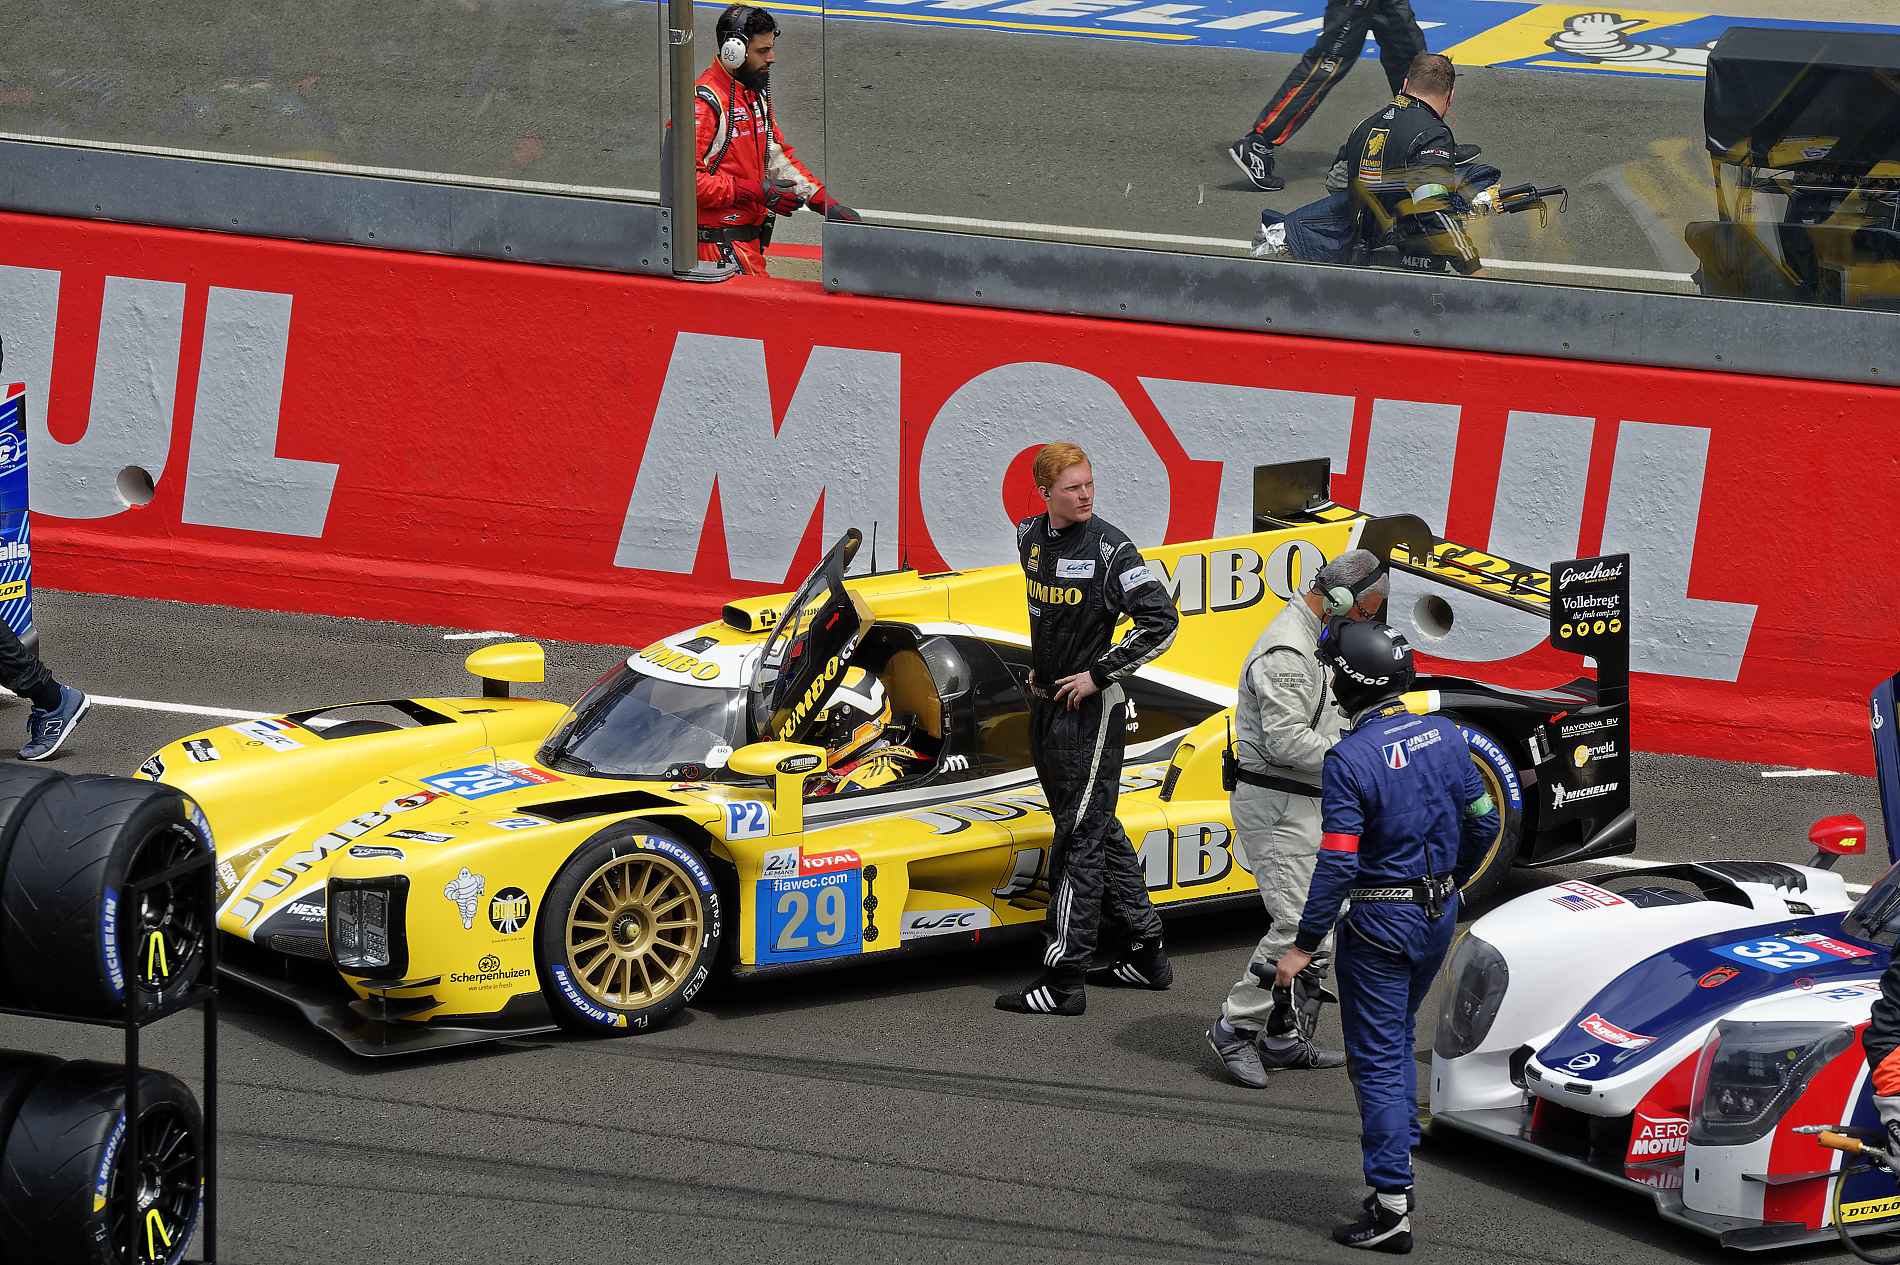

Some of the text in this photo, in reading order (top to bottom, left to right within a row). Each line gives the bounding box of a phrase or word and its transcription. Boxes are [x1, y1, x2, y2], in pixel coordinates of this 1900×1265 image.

[613, 331, 1758, 682] MOTUL
[1559, 562, 1624, 590] Goedhart
[1562, 594, 1620, 609] Vollebregt
[1562, 721, 1603, 734] MAYONNA
[1606, 717, 1619, 726] BV
[1408, 729, 1439, 747] UNITED
[1472, 734, 1520, 801] MICHELIN
[431, 770, 514, 795] 29
[1566, 782, 1619, 800] MICHELIN
[728, 802, 765, 834] P2
[657, 841, 711, 887] MICHELIN
[801, 854, 858, 868] TOTAL
[773, 873, 848, 891] fiawec.com
[777, 885, 847, 950] 29
[911, 912, 976, 929] WEC
[103, 897, 125, 991] MICHELIN
[1817, 940, 1859, 958] TOTAL
[1732, 941, 1820, 969] 32
[450, 968, 531, 984] Scherpenhuizen
[556, 970, 606, 1022] MICHELIN
[1640, 1123, 1689, 1139] AERO
[1631, 1136, 1686, 1156] MOTUL
